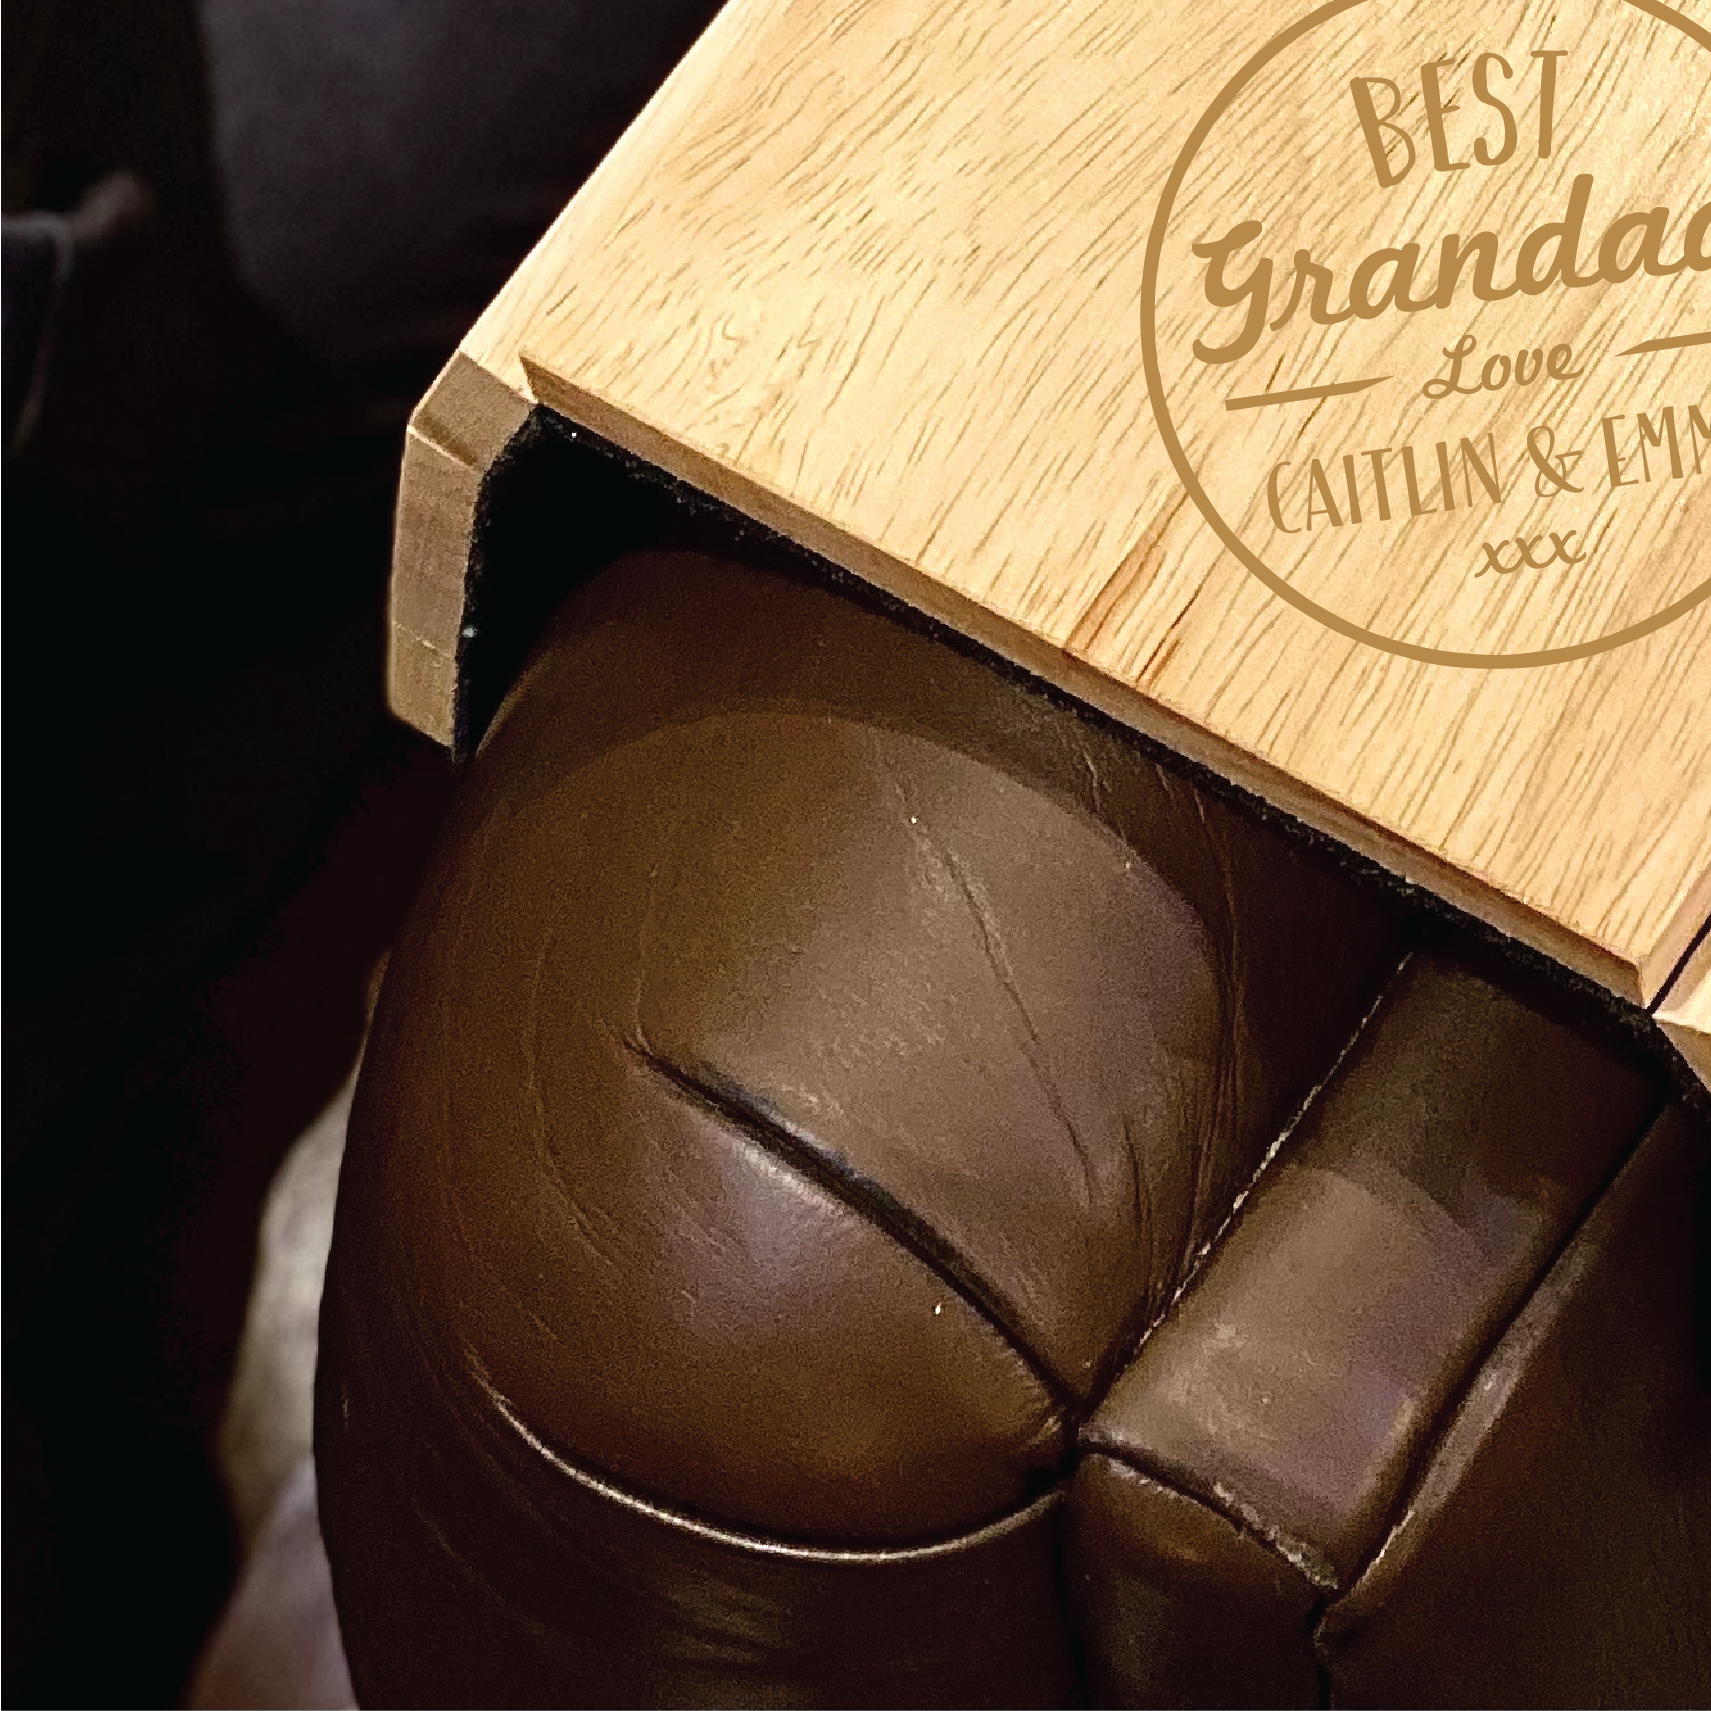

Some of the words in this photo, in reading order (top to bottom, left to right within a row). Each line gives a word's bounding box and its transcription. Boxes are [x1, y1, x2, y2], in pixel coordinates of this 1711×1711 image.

[1350, 50, 1568, 188] BEST
[1423, 334, 1585, 399] Love
[1267, 432, 1502, 534] CAITLIN
[1526, 424, 1584, 498] &
[1474, 529, 1587, 578] xxx
